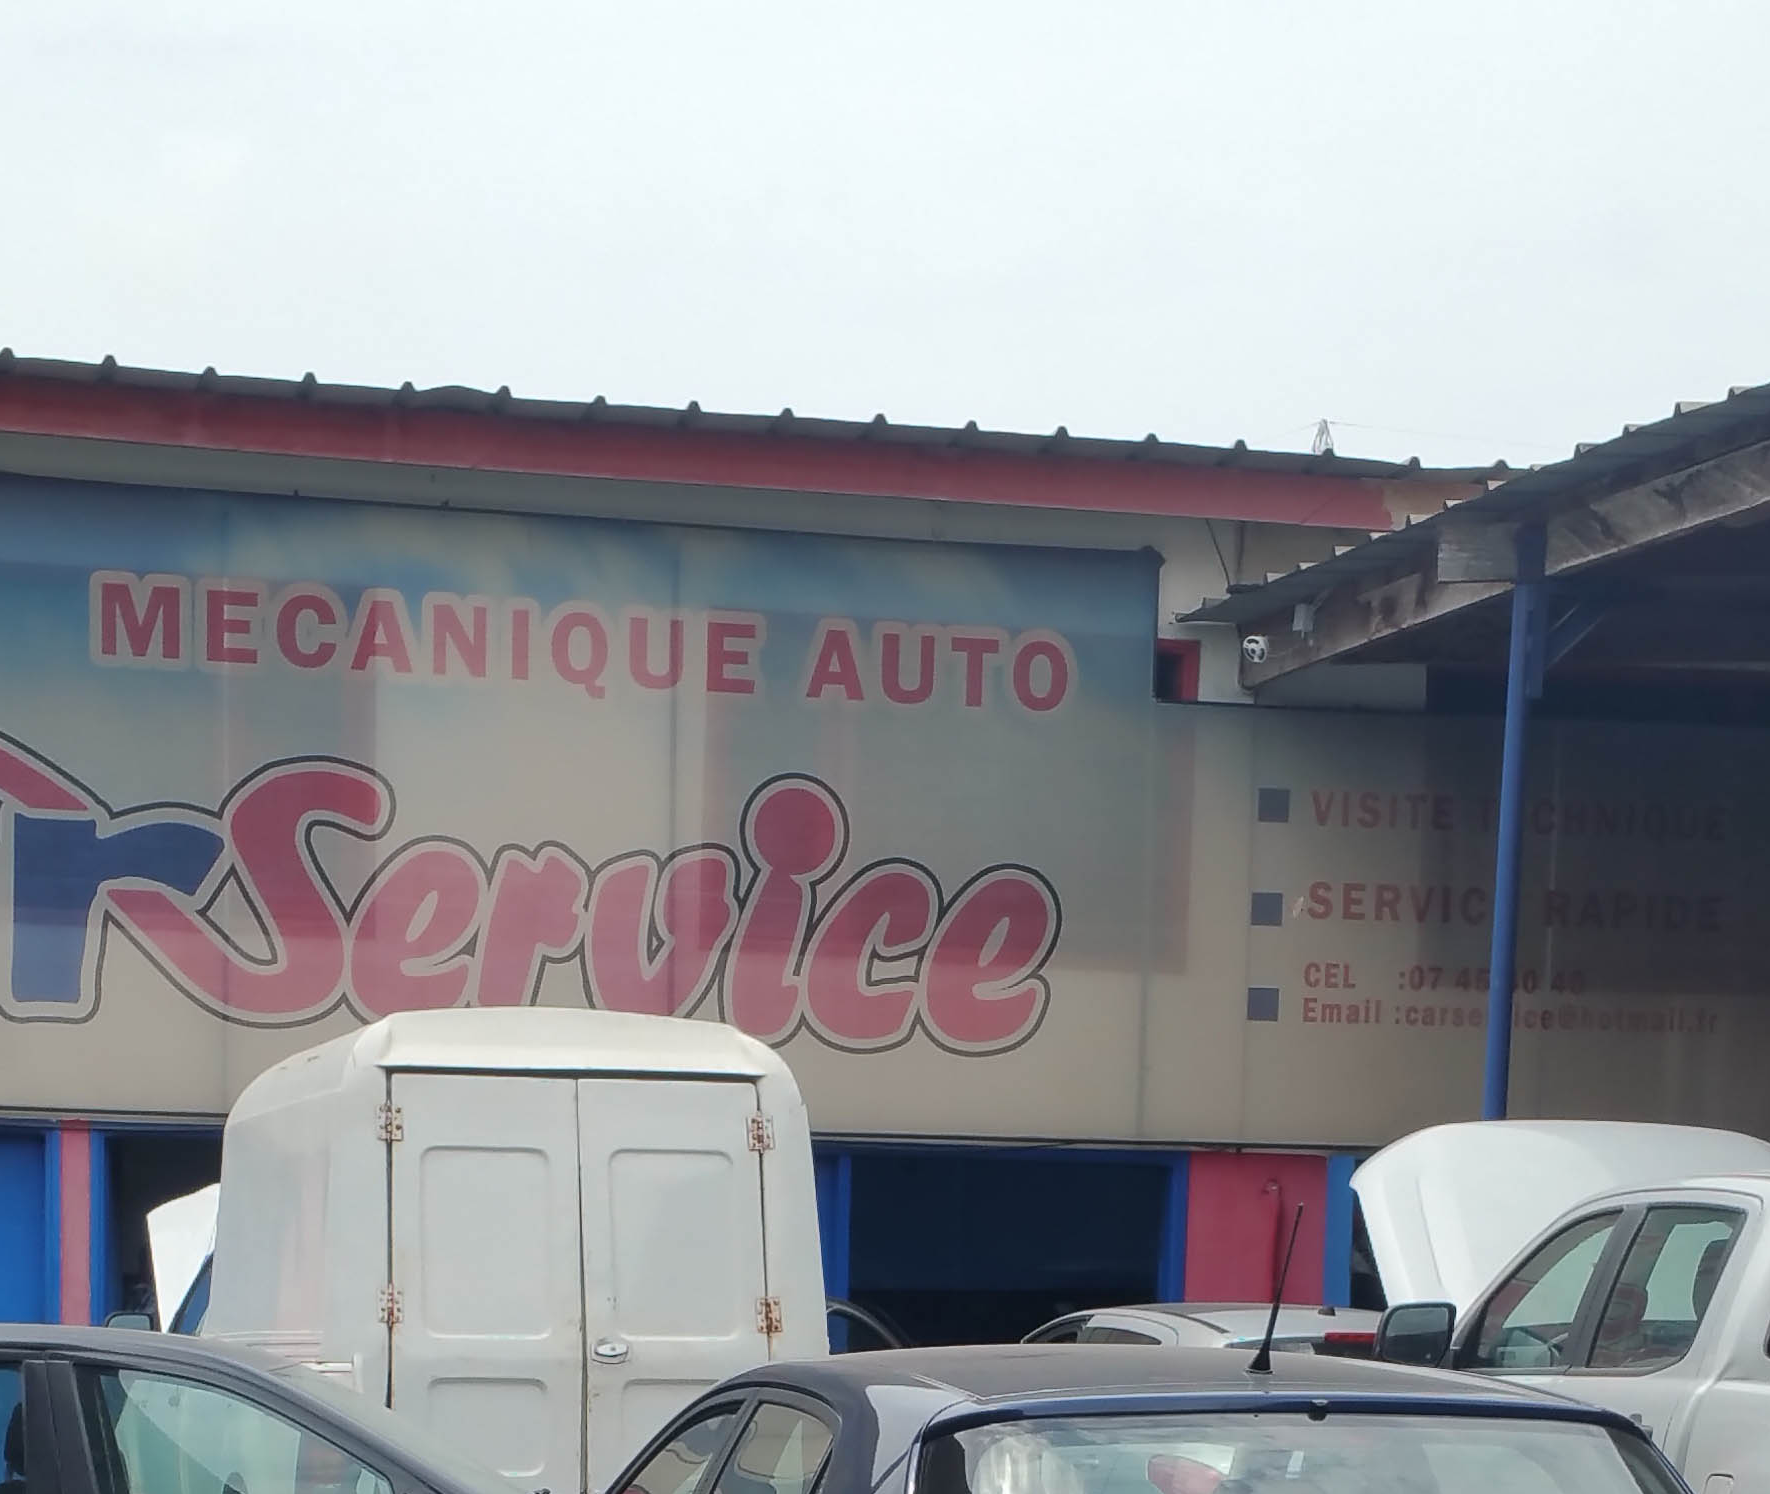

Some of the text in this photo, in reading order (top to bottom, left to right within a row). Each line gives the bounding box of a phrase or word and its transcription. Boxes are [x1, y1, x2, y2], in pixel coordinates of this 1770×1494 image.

[99, 581, 1070, 713] MECANIQUE AUTO
[1310, 790, 1728, 844] VISITE TCHNIQUE
[1306, 881, 1724, 932] SERVIC RAPIDE
[1302, 961, 1356, 990] CEL
[1301, 997, 1382, 1024] Email
